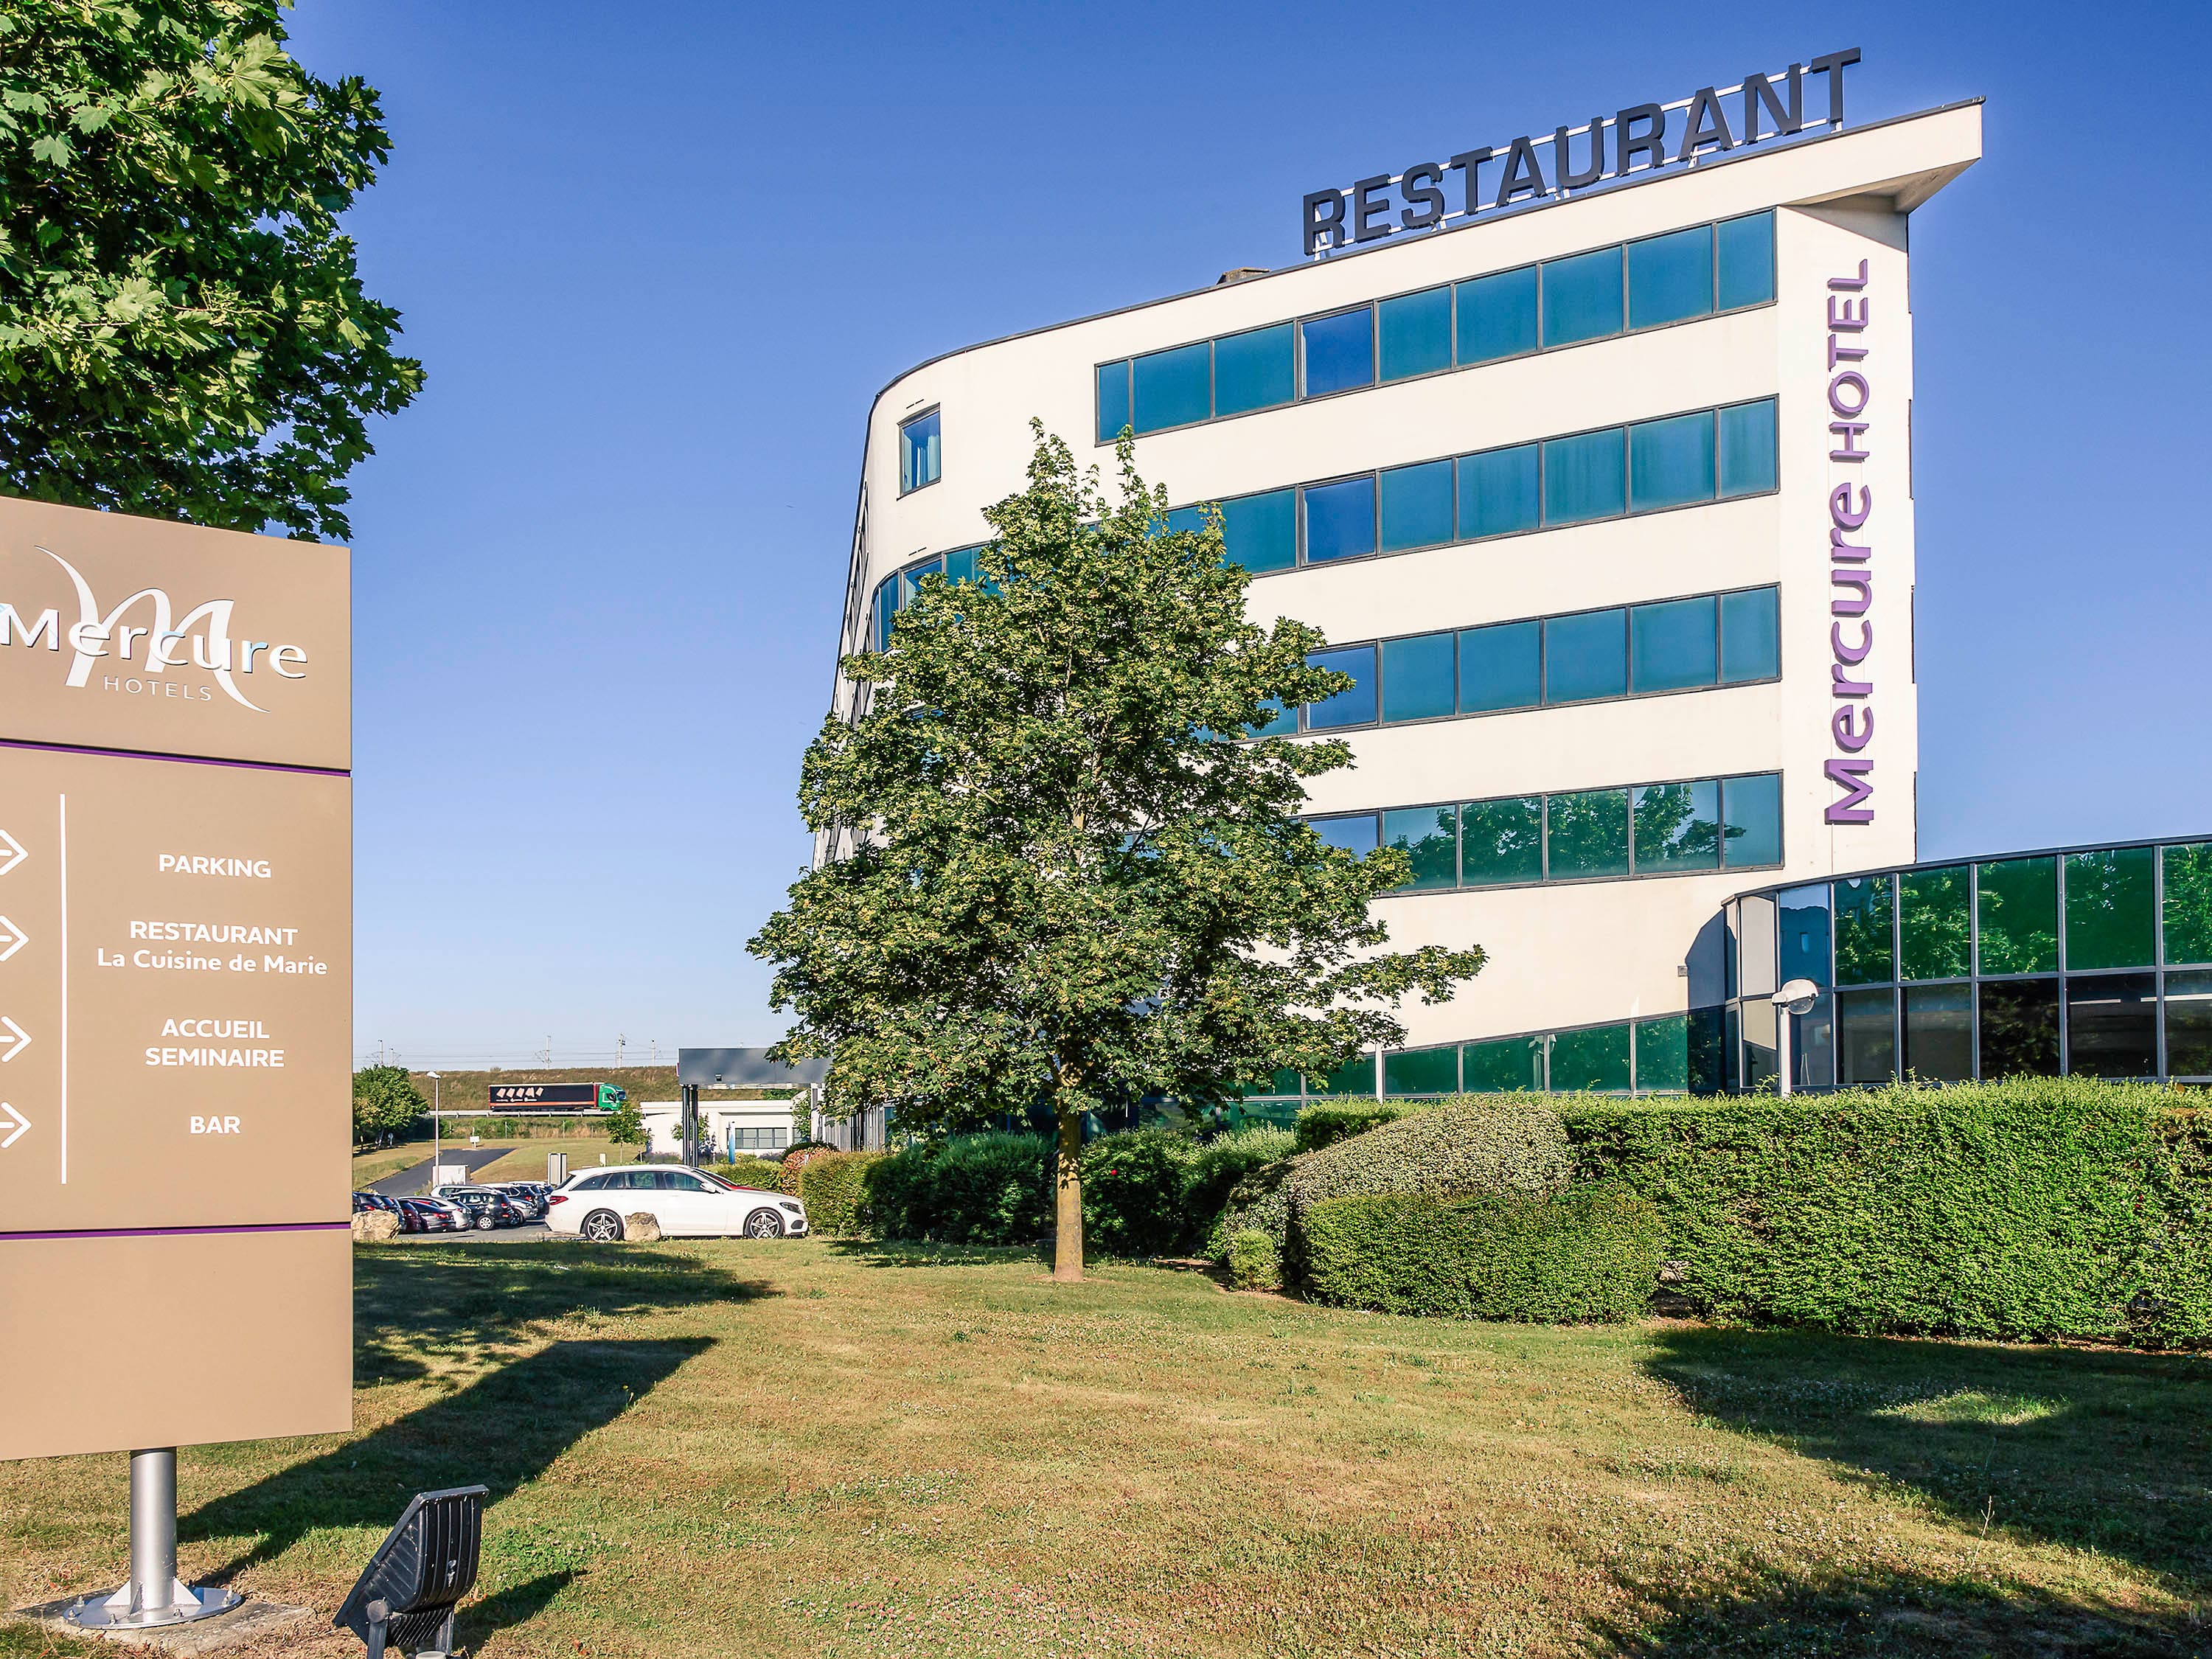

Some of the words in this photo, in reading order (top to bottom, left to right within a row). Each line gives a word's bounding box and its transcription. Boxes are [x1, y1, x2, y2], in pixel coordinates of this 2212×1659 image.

[1303, 47, 1861, 256] RESTAURANT
[1827, 258, 1871, 462] HOTEL
[0, 602, 307, 678] Mercure
[1824, 481, 1874, 827] Mercure
[103, 675, 212, 701] HOTELS
[158, 853, 272, 879] PARKING
[129, 919, 299, 946] RESTAURANT
[97, 947, 125, 967] La
[133, 949, 221, 971] Cuisine
[229, 953, 257, 973] de
[264, 955, 327, 975] Marie
[161, 1018, 270, 1039] ACCUEIL
[145, 1047, 285, 1068] SEMINAIRE
[189, 1116, 240, 1134] BAR
